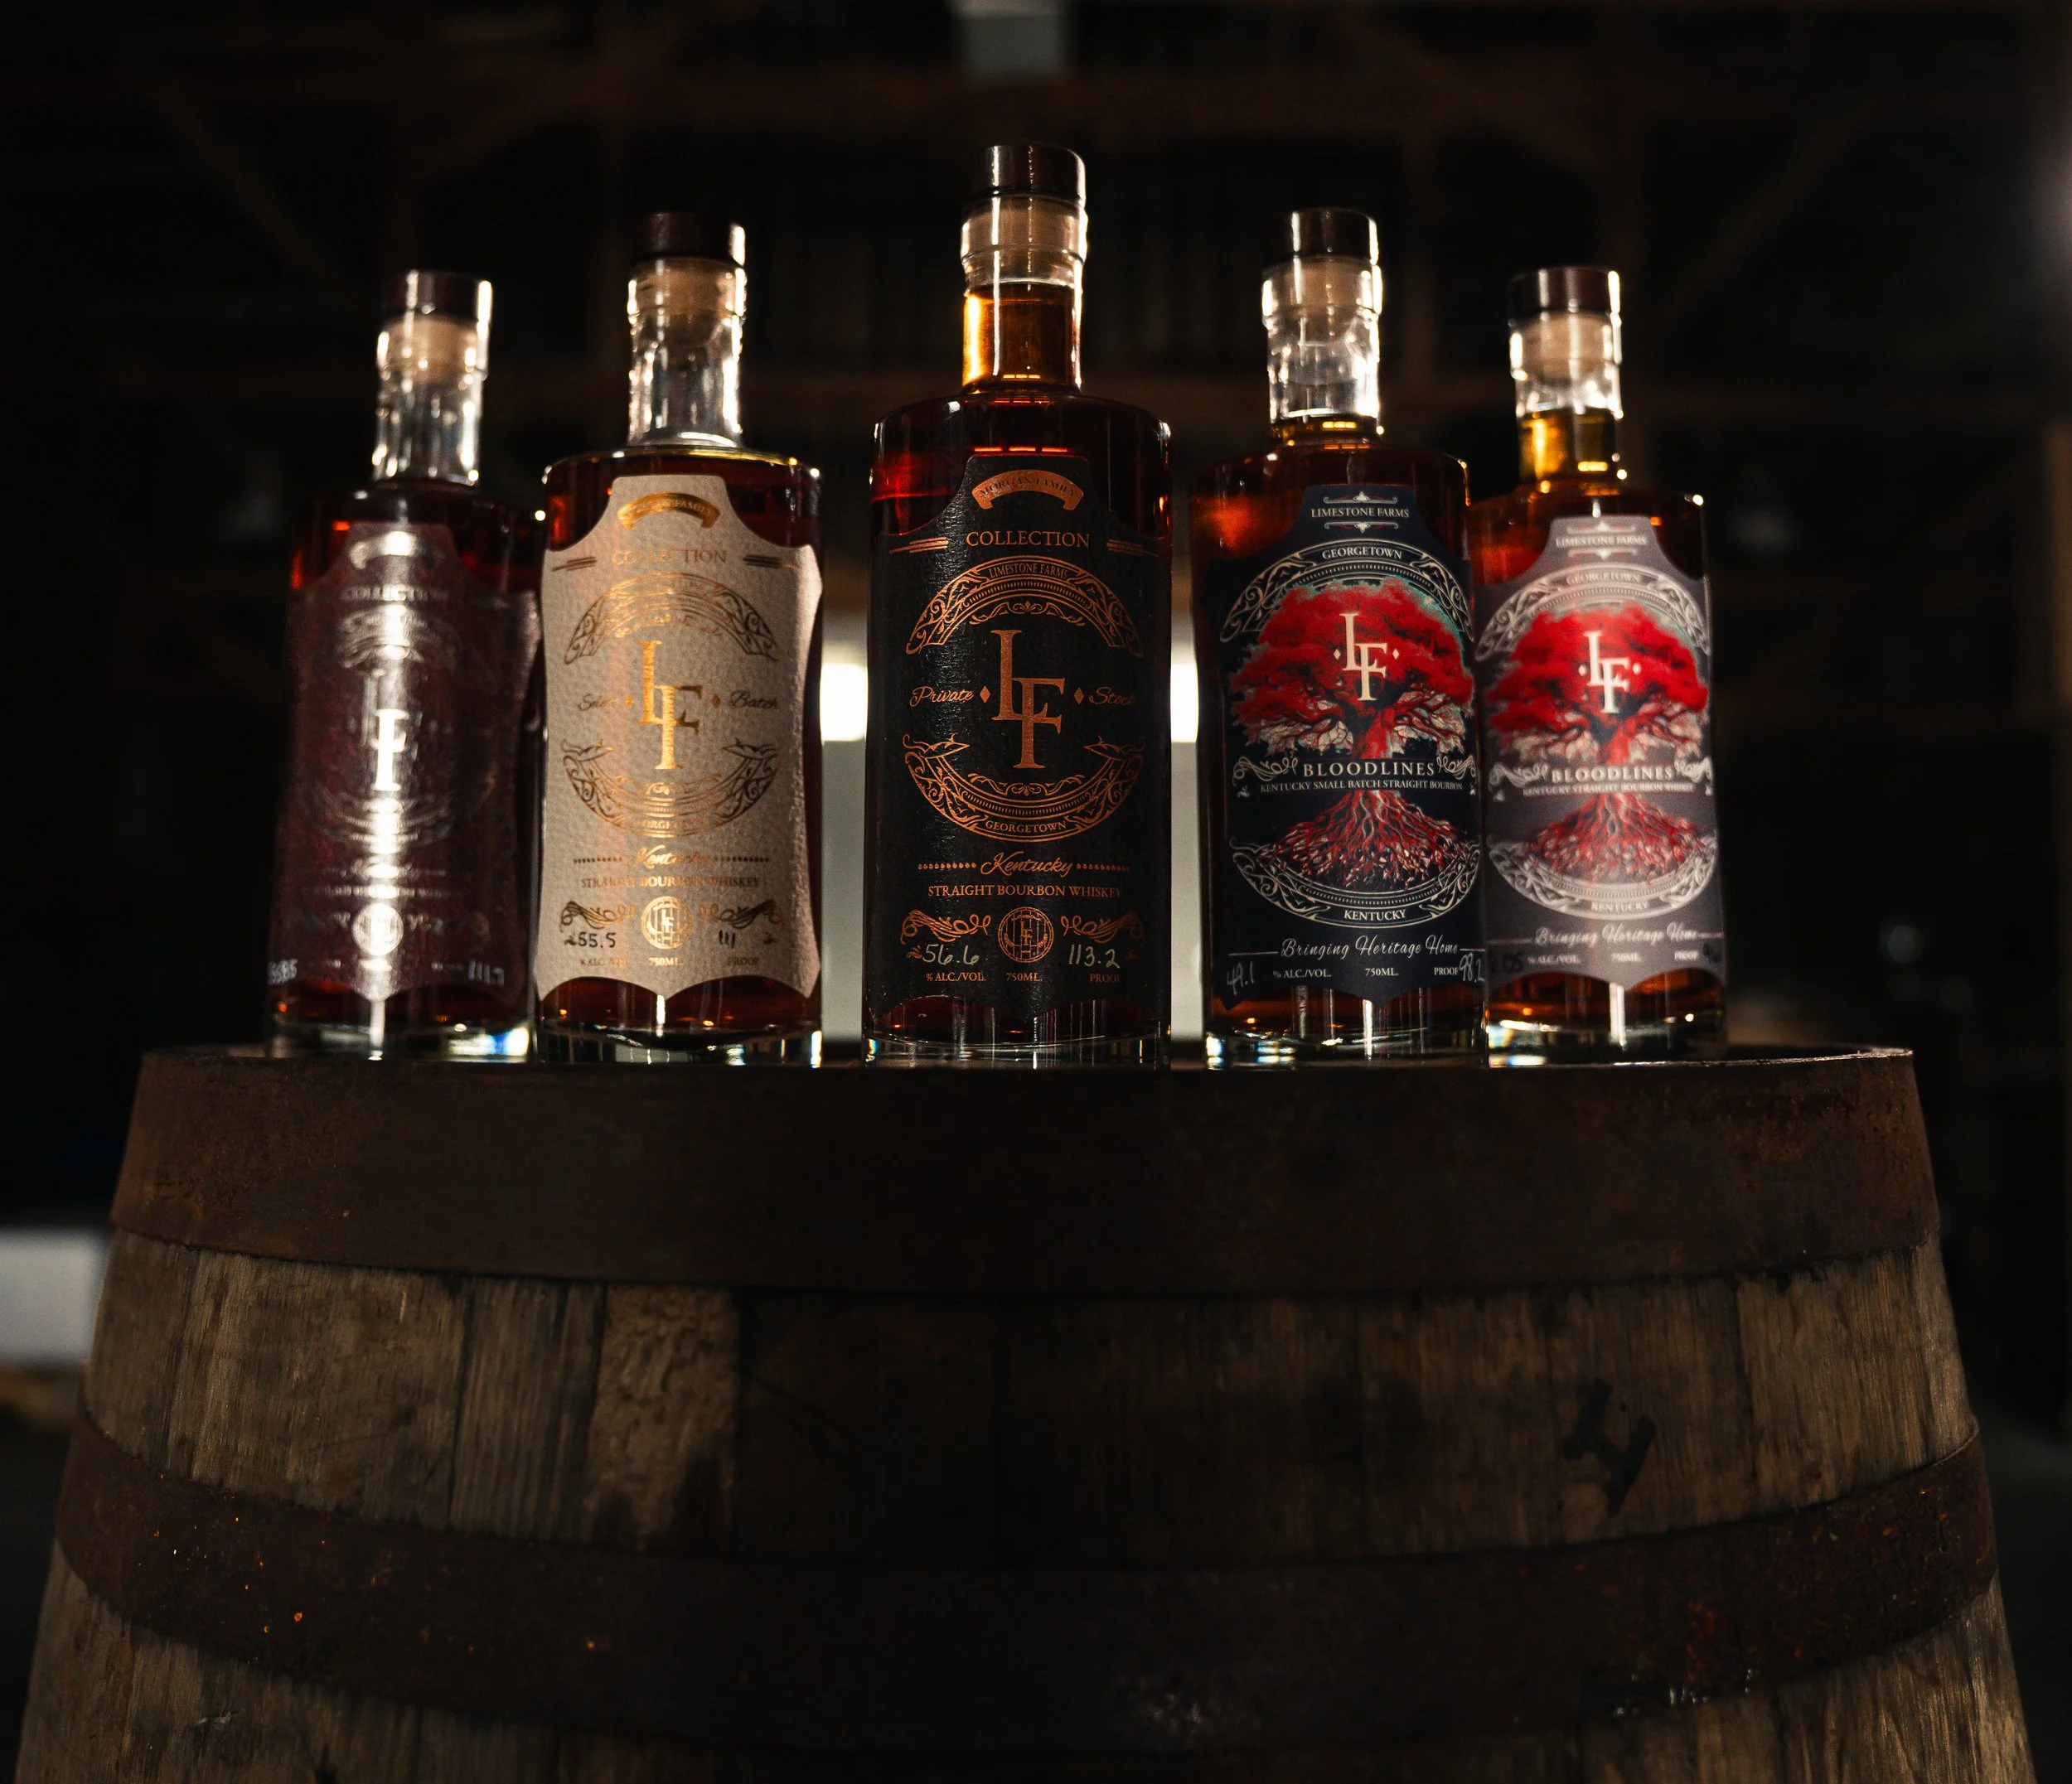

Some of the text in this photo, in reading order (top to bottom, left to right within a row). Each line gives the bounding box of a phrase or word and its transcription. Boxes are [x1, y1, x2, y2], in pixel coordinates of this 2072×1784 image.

[1310, 507, 1410, 519] LIMESTONE FARMS
[965, 529, 1091, 548] COLLECTION
[1555, 534, 1648, 547] LIMESTONE FARMS
[1321, 546, 1402, 560] GEORGETOWN
[988, 563, 1069, 579] LIMESTONE FARMS
[1339, 612, 1388, 702] LF
[909, 685, 975, 708] Private
[990, 629, 1067, 770] LF
[1302, 761, 1435, 778] BLOODLINES
[1552, 766, 1674, 784] BLOODLINES
[1260, 779, 1464, 793] KENTUCKY SMALL BATCH STRAIGHT BOURBON
[985, 819, 1067, 834] GEORGETOWN
[980, 850, 1073, 878] Kentucky
[927, 884, 995, 897] STRAIGHT
[997, 884, 1066, 897] BOURBON
[1591, 901, 1649, 912] KENTUCKY
[1343, 908, 1406, 922] KENTUCKY
[578, 931, 617, 949] 55.5
[1535, 926, 1599, 949] Bringing
[1600, 921, 1666, 946] Heritage
[1280, 933, 1459, 960] Bringing Heritage Home
[1068, 944, 1121, 969] 113.2
[925, 973, 933, 982] %
[1005, 972, 1044, 982] 750ML.
[1284, 968, 1332, 979] ALC./VOL.
[1364, 967, 1399, 977] 750ML.
[1433, 966, 1459, 976] PROOF
